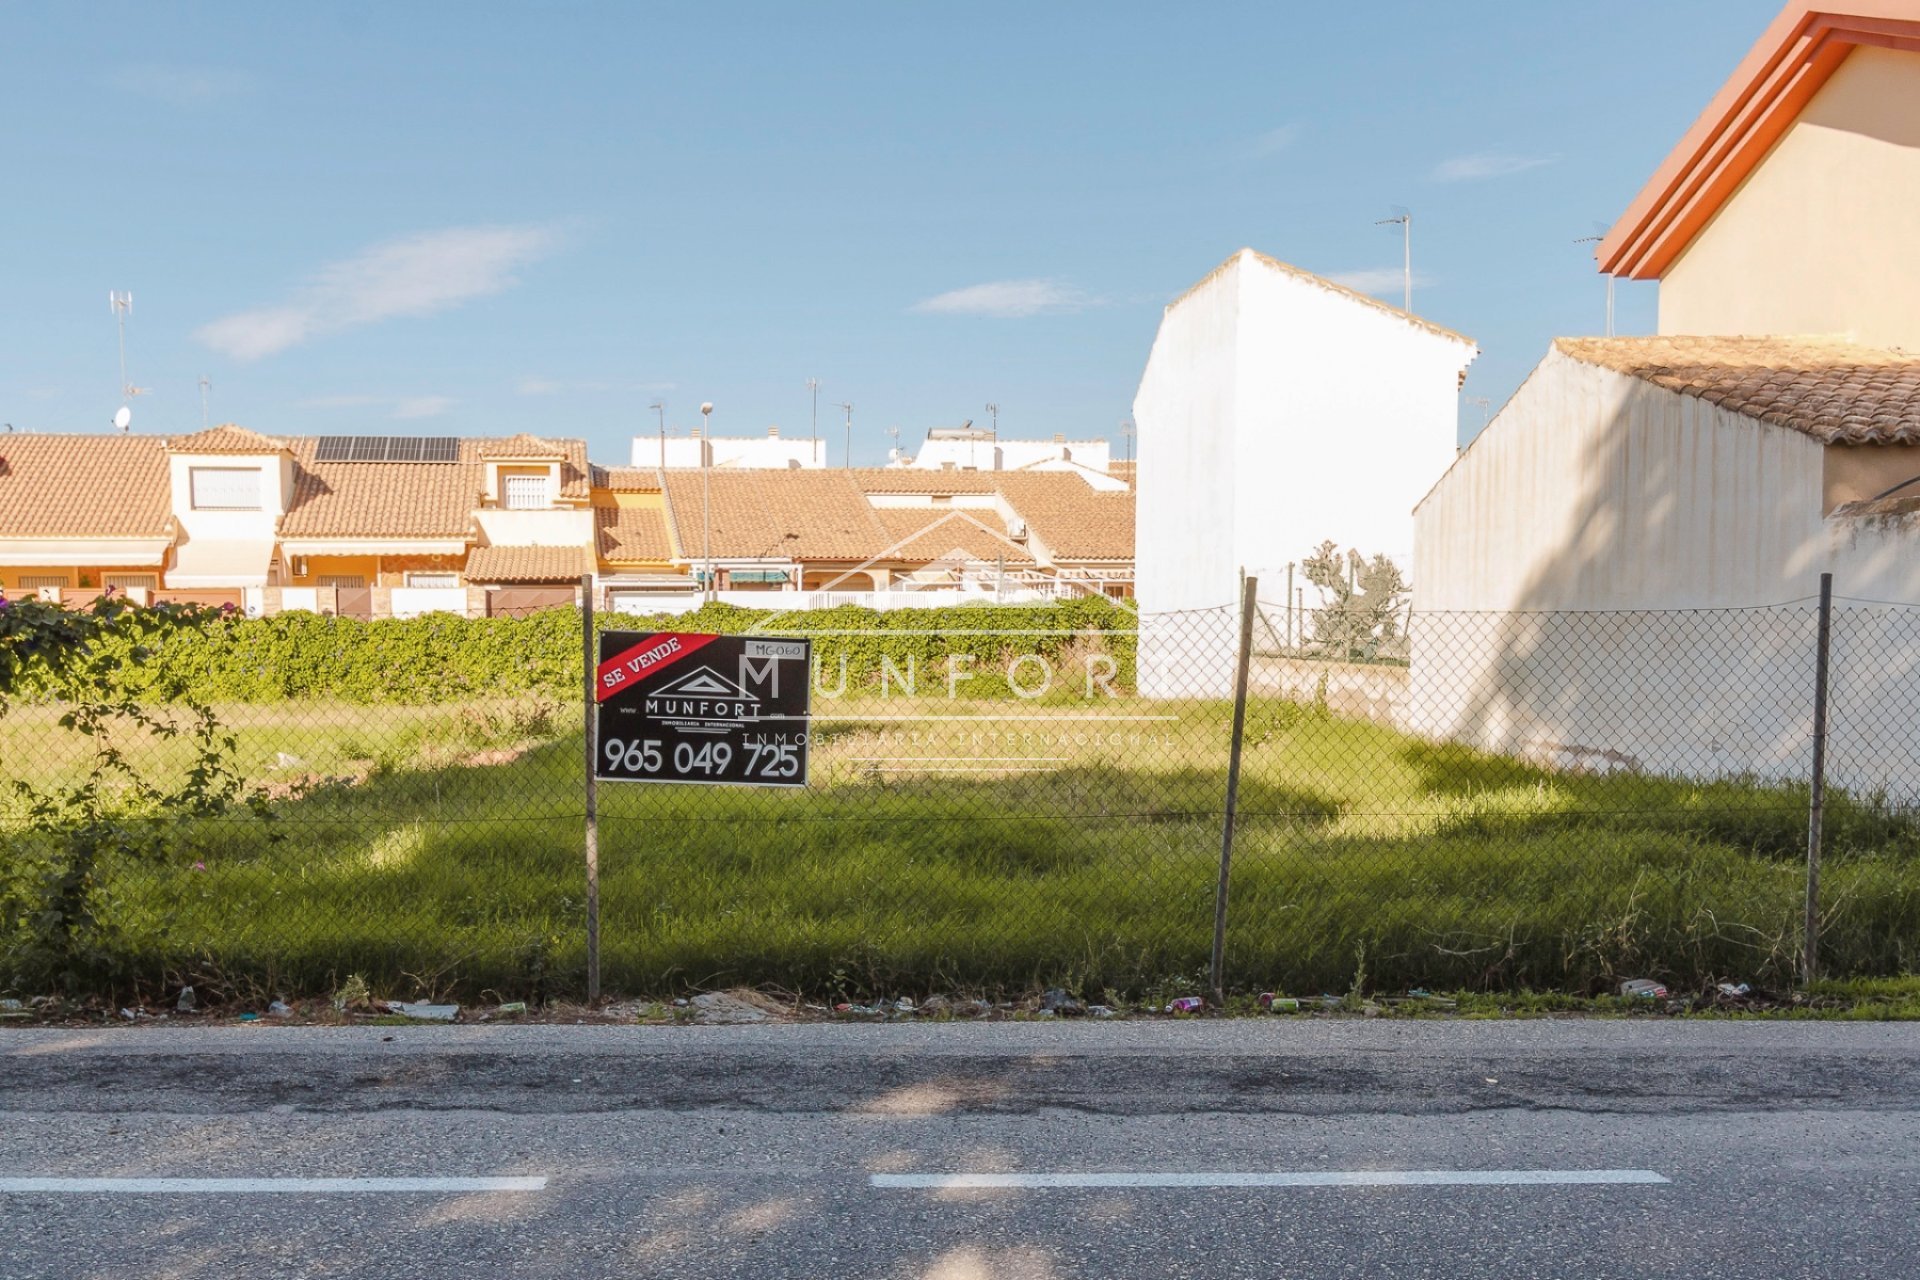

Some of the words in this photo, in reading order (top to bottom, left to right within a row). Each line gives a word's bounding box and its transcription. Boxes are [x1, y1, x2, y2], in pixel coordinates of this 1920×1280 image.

[603, 668, 626, 688] SE
[627, 637, 682, 673] VENDE
[645, 699, 761, 718] MUNFORT
[704, 721, 745, 729] INTERNACIONAL
[605, 738, 662, 772] 965
[674, 742, 732, 775] 049
[743, 744, 798, 777] 725
